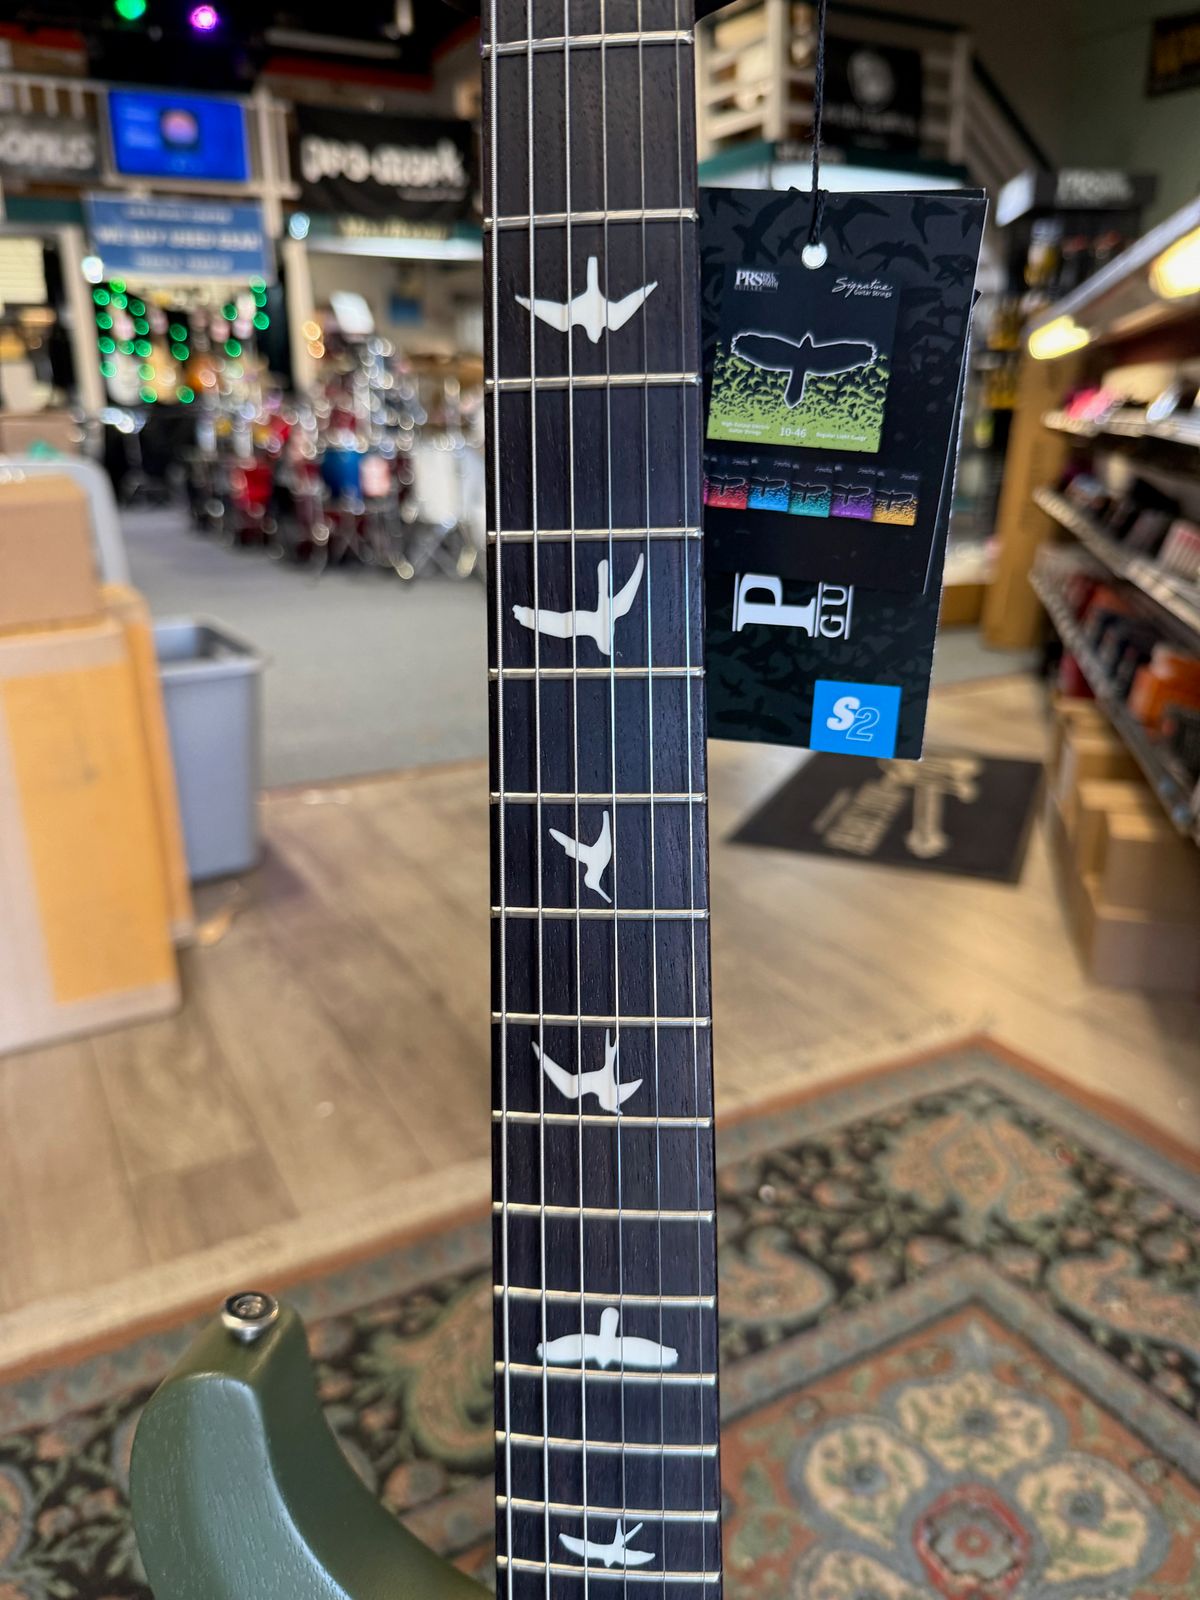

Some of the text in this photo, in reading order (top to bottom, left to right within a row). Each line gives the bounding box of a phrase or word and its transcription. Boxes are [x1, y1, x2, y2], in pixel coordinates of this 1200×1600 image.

[735, 269, 763, 286] PRS
[832, 277, 894, 298] Signature
[779, 426, 807, 439] 10-46
[826, 696, 880, 742] S2
